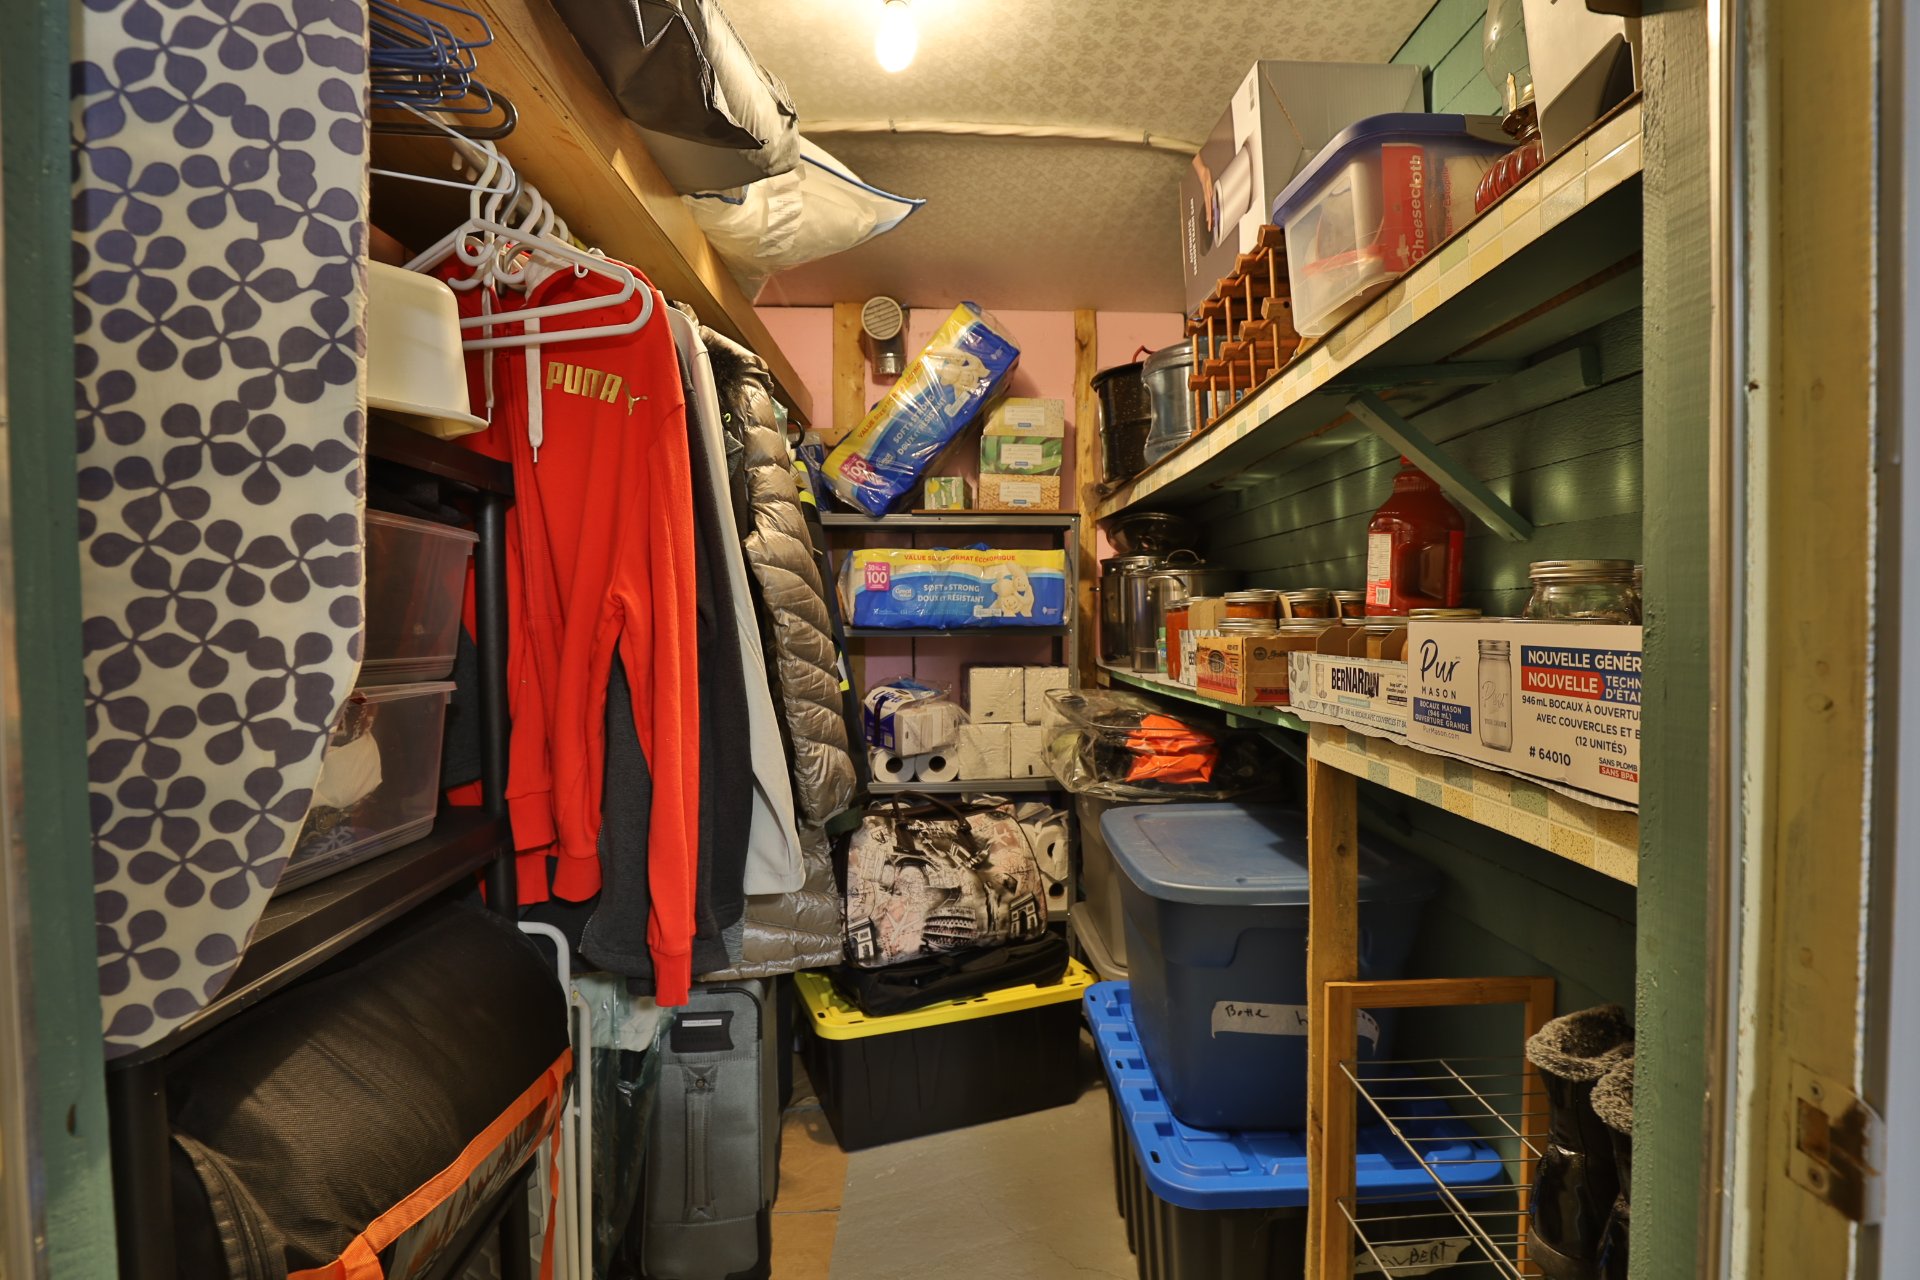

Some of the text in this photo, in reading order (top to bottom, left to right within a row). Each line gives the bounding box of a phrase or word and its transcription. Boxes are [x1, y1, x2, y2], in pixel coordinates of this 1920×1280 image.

[1409, 155, 1425, 262] Cheesecloth
[546, 361, 622, 404] PUMA
[858, 421, 875, 439] VALUE
[893, 422, 912, 443] SOFT
[897, 436, 915, 455] DOUX
[847, 460, 867, 480] 100
[866, 571, 887, 584] 100
[923, 584, 944, 592] SOFT
[948, 584, 980, 593] STRONG
[947, 594, 985, 603] RÉSISTANT
[1420, 639, 1460, 683] Pur
[1528, 650, 1642, 673] NOUVELLE GÉNÉR
[1331, 666, 1380, 697] BERNARDIN
[1528, 671, 1598, 694] NOUVELLE
[1421, 685, 1457, 700] MASON
[1419, 700, 1440, 711] BOCAUX
[1441, 703, 1462, 714] MASON
[1521, 695, 1640, 721] 946 mL BOCAUX À OUVERTU
[1414, 713, 1444, 726] OUVERTURE
[1445, 720, 1470, 732] GRANDE
[1536, 713, 1557, 725] AVEC
[1558, 716, 1618, 736] COUVERCLES
[1620, 727, 1632, 738] ET
[1529, 745, 1571, 767] # 64010
[1575, 736, 1627, 756] (12 UNITÉS)
[1599, 757, 1638, 772] SANS PLOMB
[1601, 766, 1635, 782] SANS BPA
